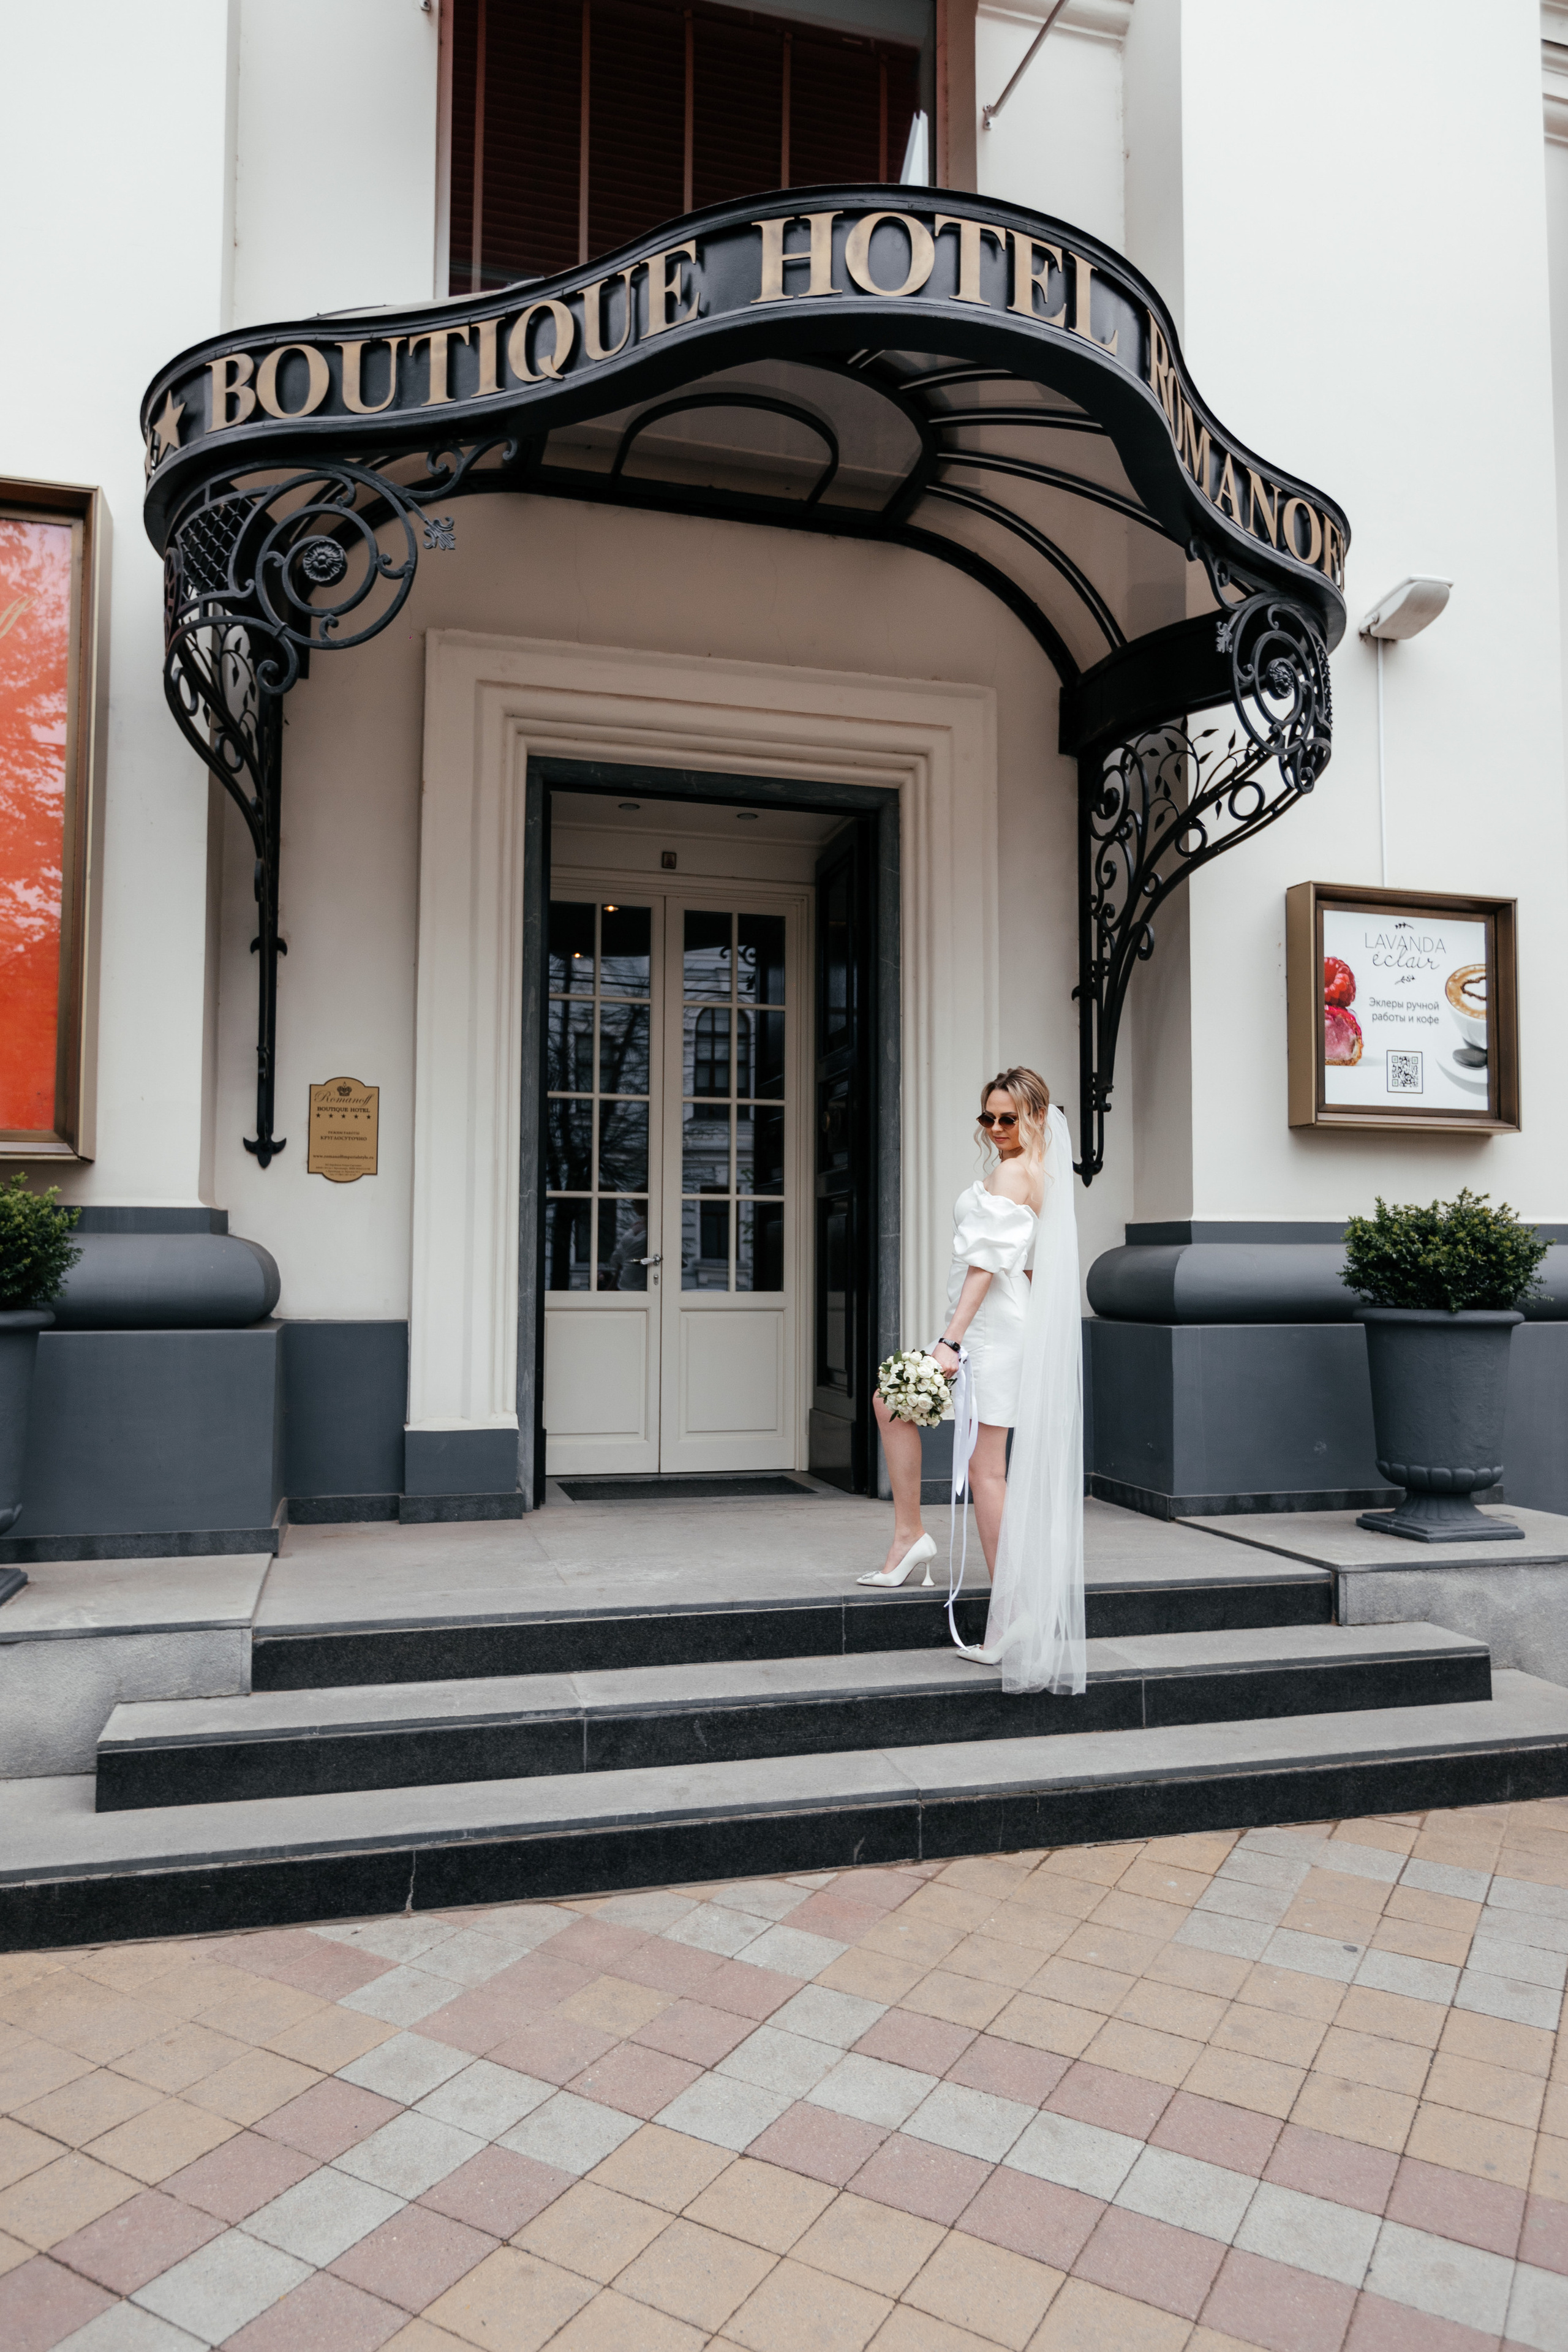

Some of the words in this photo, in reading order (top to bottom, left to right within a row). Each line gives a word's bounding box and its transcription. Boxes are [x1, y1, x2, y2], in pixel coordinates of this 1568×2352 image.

[206, 239, 702, 435] BOUTIQUE
[751, 211, 1118, 356] HOTEL
[1365, 932, 1446, 954] LAVANDA
[1372, 946, 1440, 970] éclair
[1368, 997, 1404, 1010] Эклеры
[1406, 1001, 1439, 1011] ручной
[1371, 1012, 1406, 1023] работы
[1417, 1014, 1439, 1025] кофе
[314, 1090, 375, 1107] Romanoff
